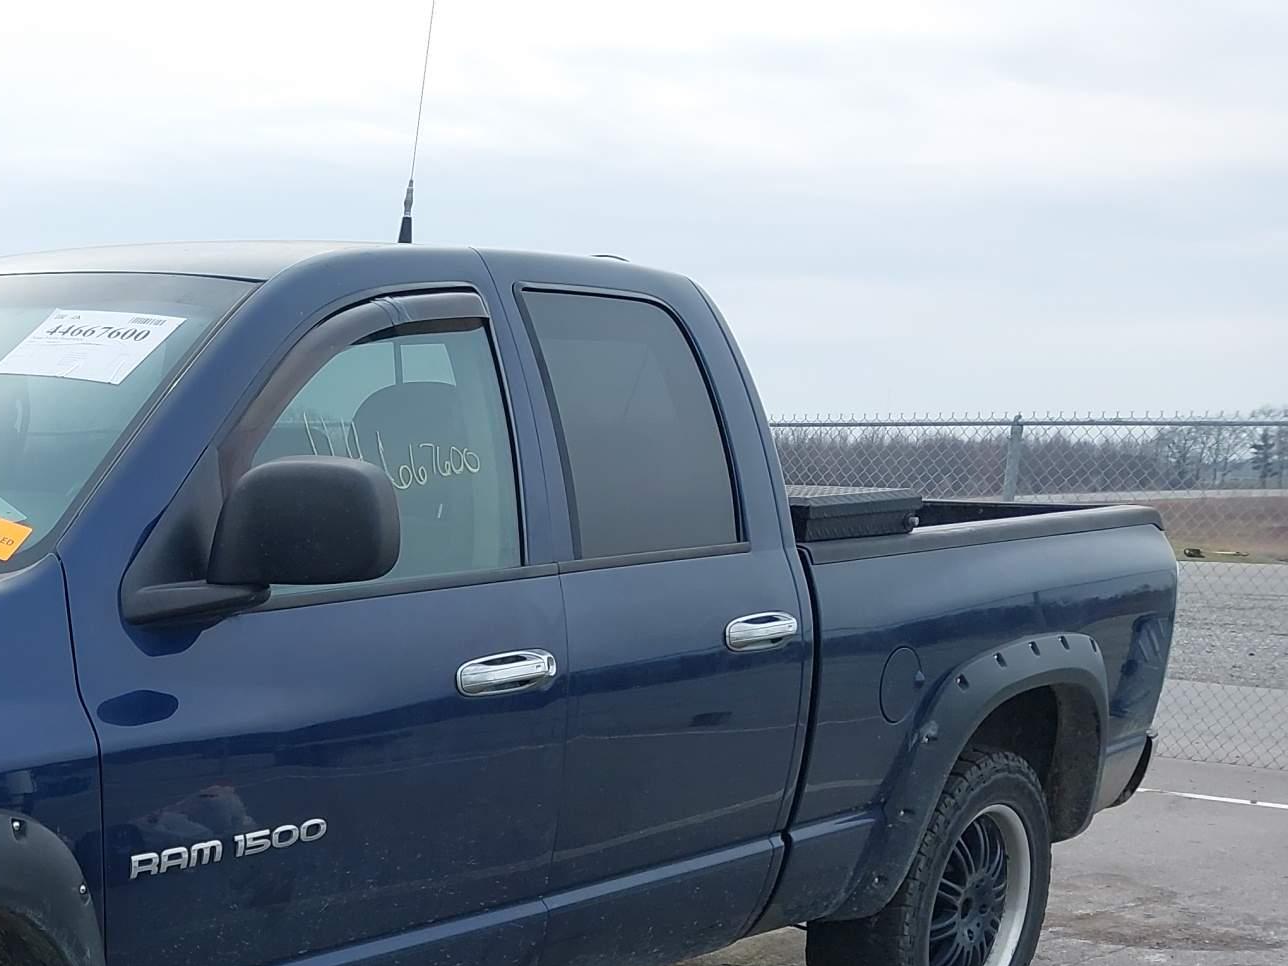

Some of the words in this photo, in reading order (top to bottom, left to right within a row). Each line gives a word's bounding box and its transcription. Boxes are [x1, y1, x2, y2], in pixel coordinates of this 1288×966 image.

[46, 323, 151, 343] 44667600
[129, 838, 223, 880] RAM
[233, 817, 327, 858] 1500
